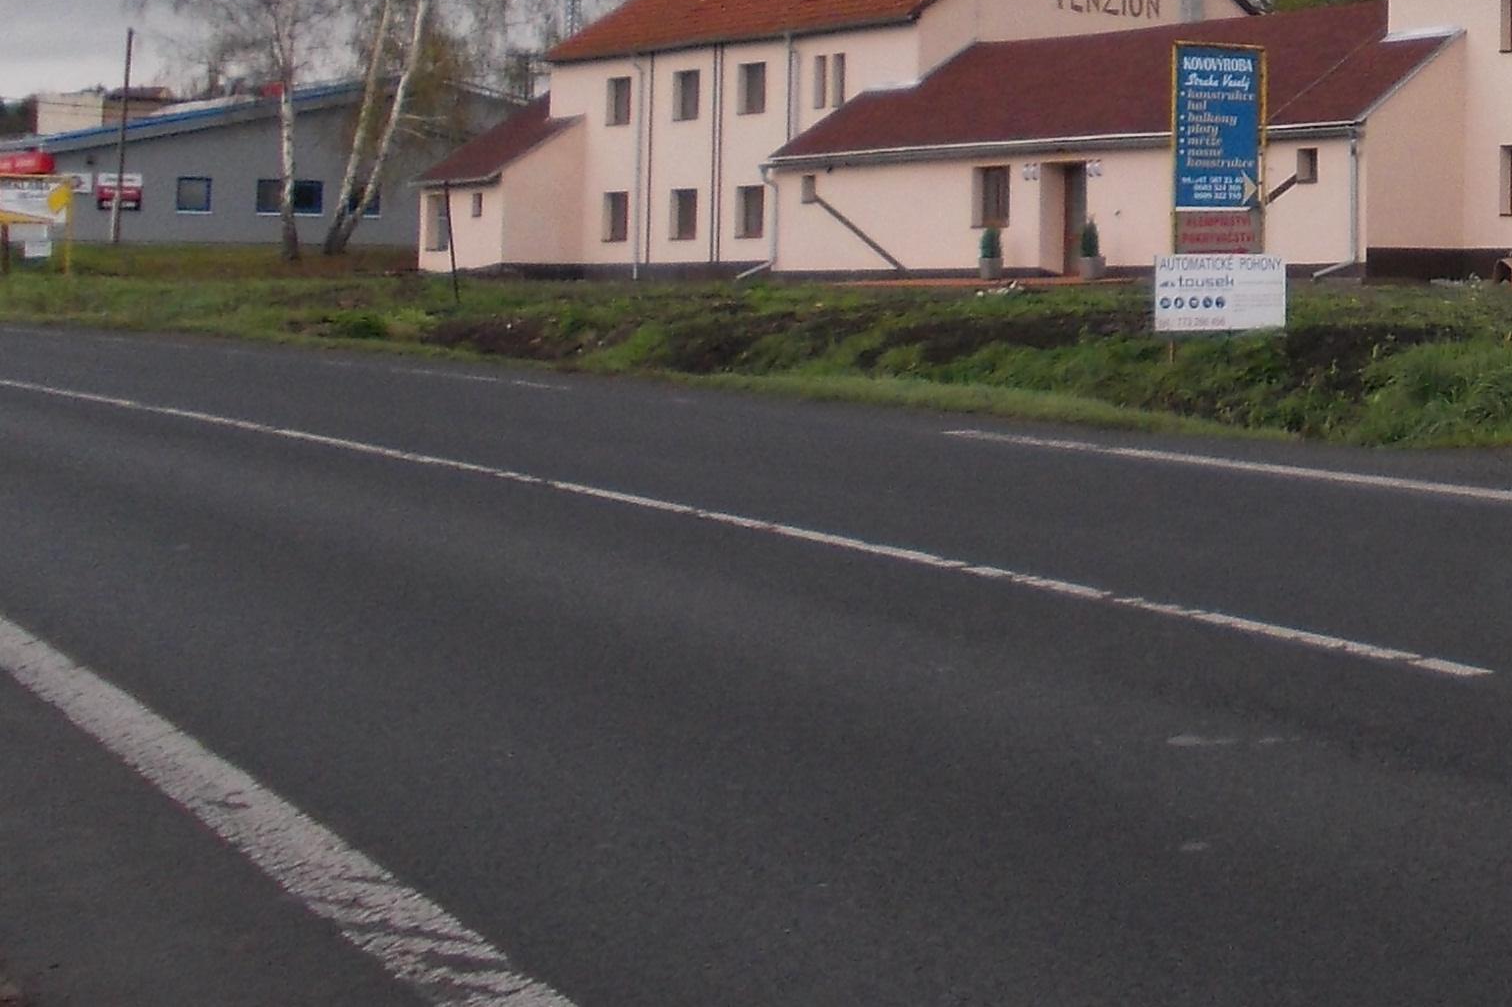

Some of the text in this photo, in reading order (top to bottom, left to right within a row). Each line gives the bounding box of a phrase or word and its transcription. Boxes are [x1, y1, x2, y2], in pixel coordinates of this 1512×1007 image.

[1183, 54, 1253, 72] KOVOVÝROBA
[1187, 112, 1238, 126] balkony
[1187, 124, 1219, 136] ploty
[1186, 156, 1255, 168] konstrukce
[1160, 254, 1282, 271] AUTOMATICKÉ POHONY
[1179, 275, 1234, 288] tousek
